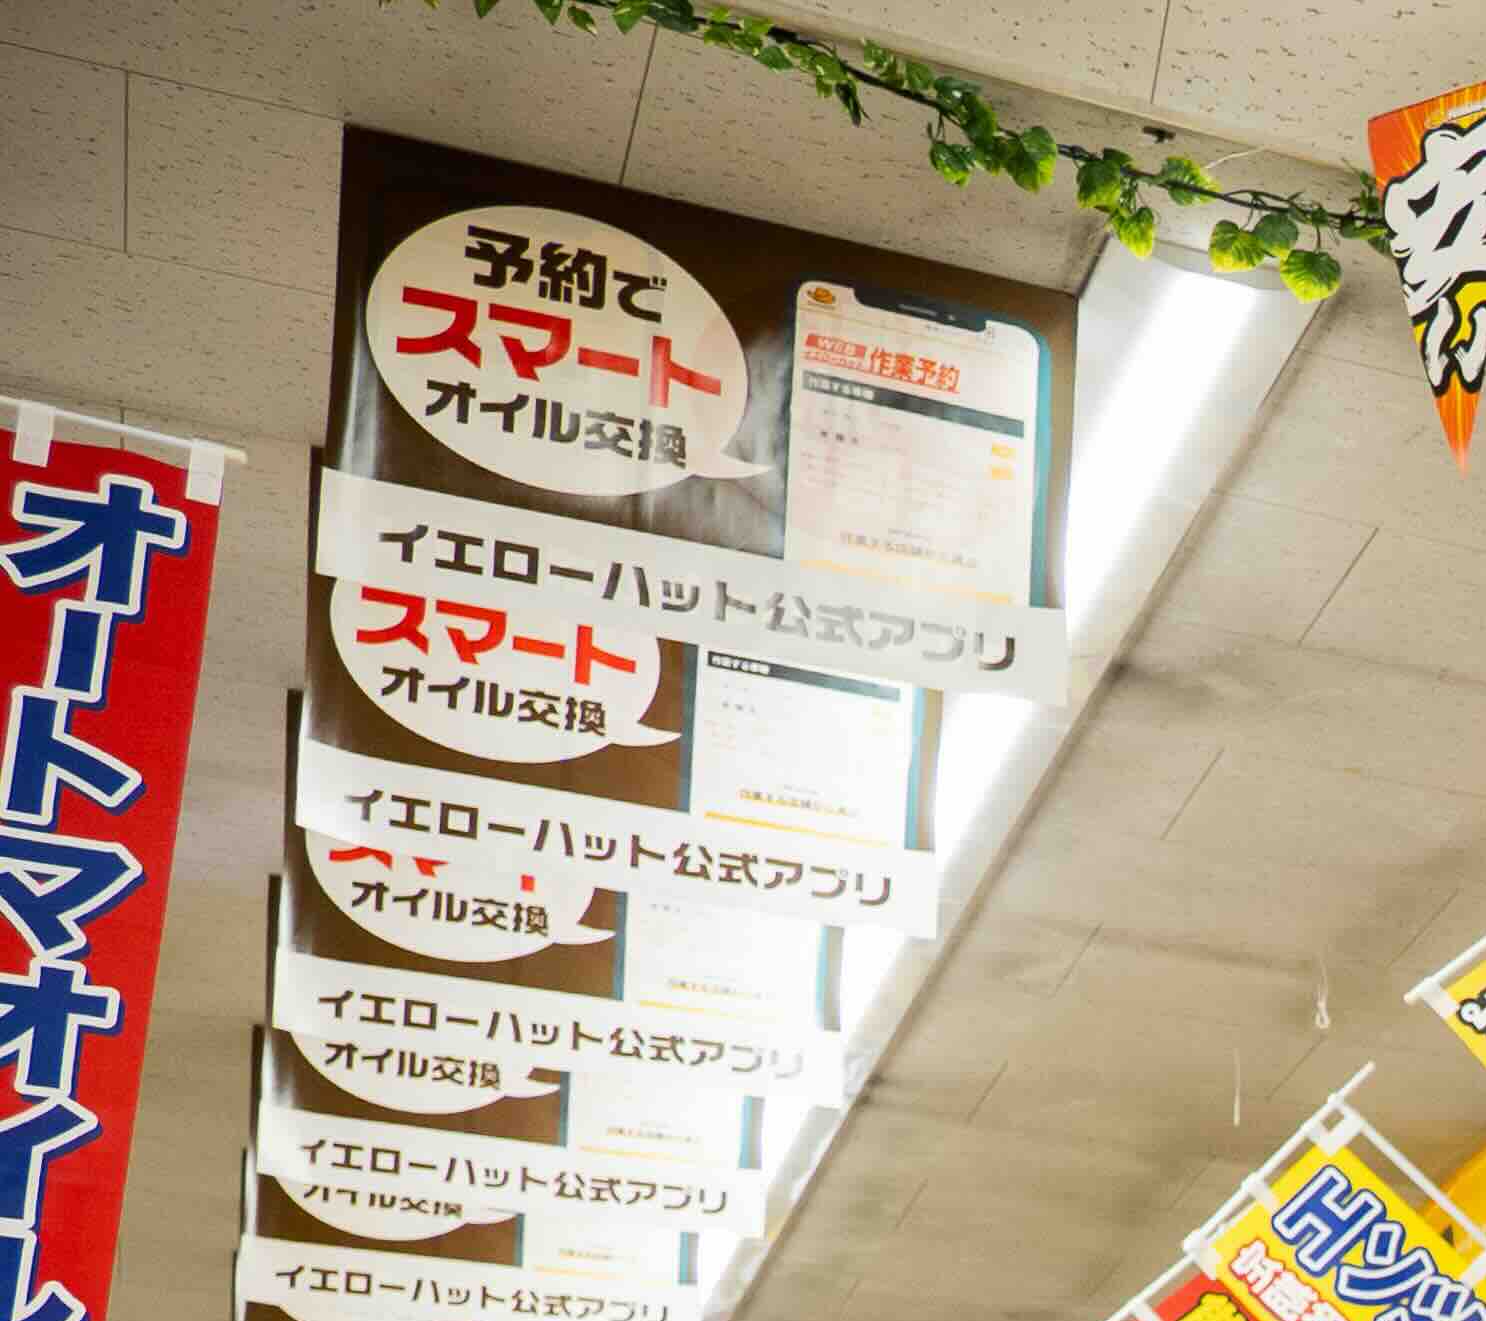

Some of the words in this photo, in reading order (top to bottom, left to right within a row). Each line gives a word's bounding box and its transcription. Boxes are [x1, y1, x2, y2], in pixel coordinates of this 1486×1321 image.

[466, 225, 668, 321] 予約で
[397, 288, 722, 408] スマート
[425, 380, 688, 469] オイル交換
[356, 589, 638, 688] スマート
[379, 525, 1017, 672] イエローハット公式アプリ
[382, 663, 608, 739] オイル交換
[347, 790, 892, 907] イエローハット公式アプリ
[350, 881, 549, 937] オイル交換
[317, 988, 806, 1080] イエローハット公式アプリ
[301, 1139, 727, 1215] イエローハット公式アプリ
